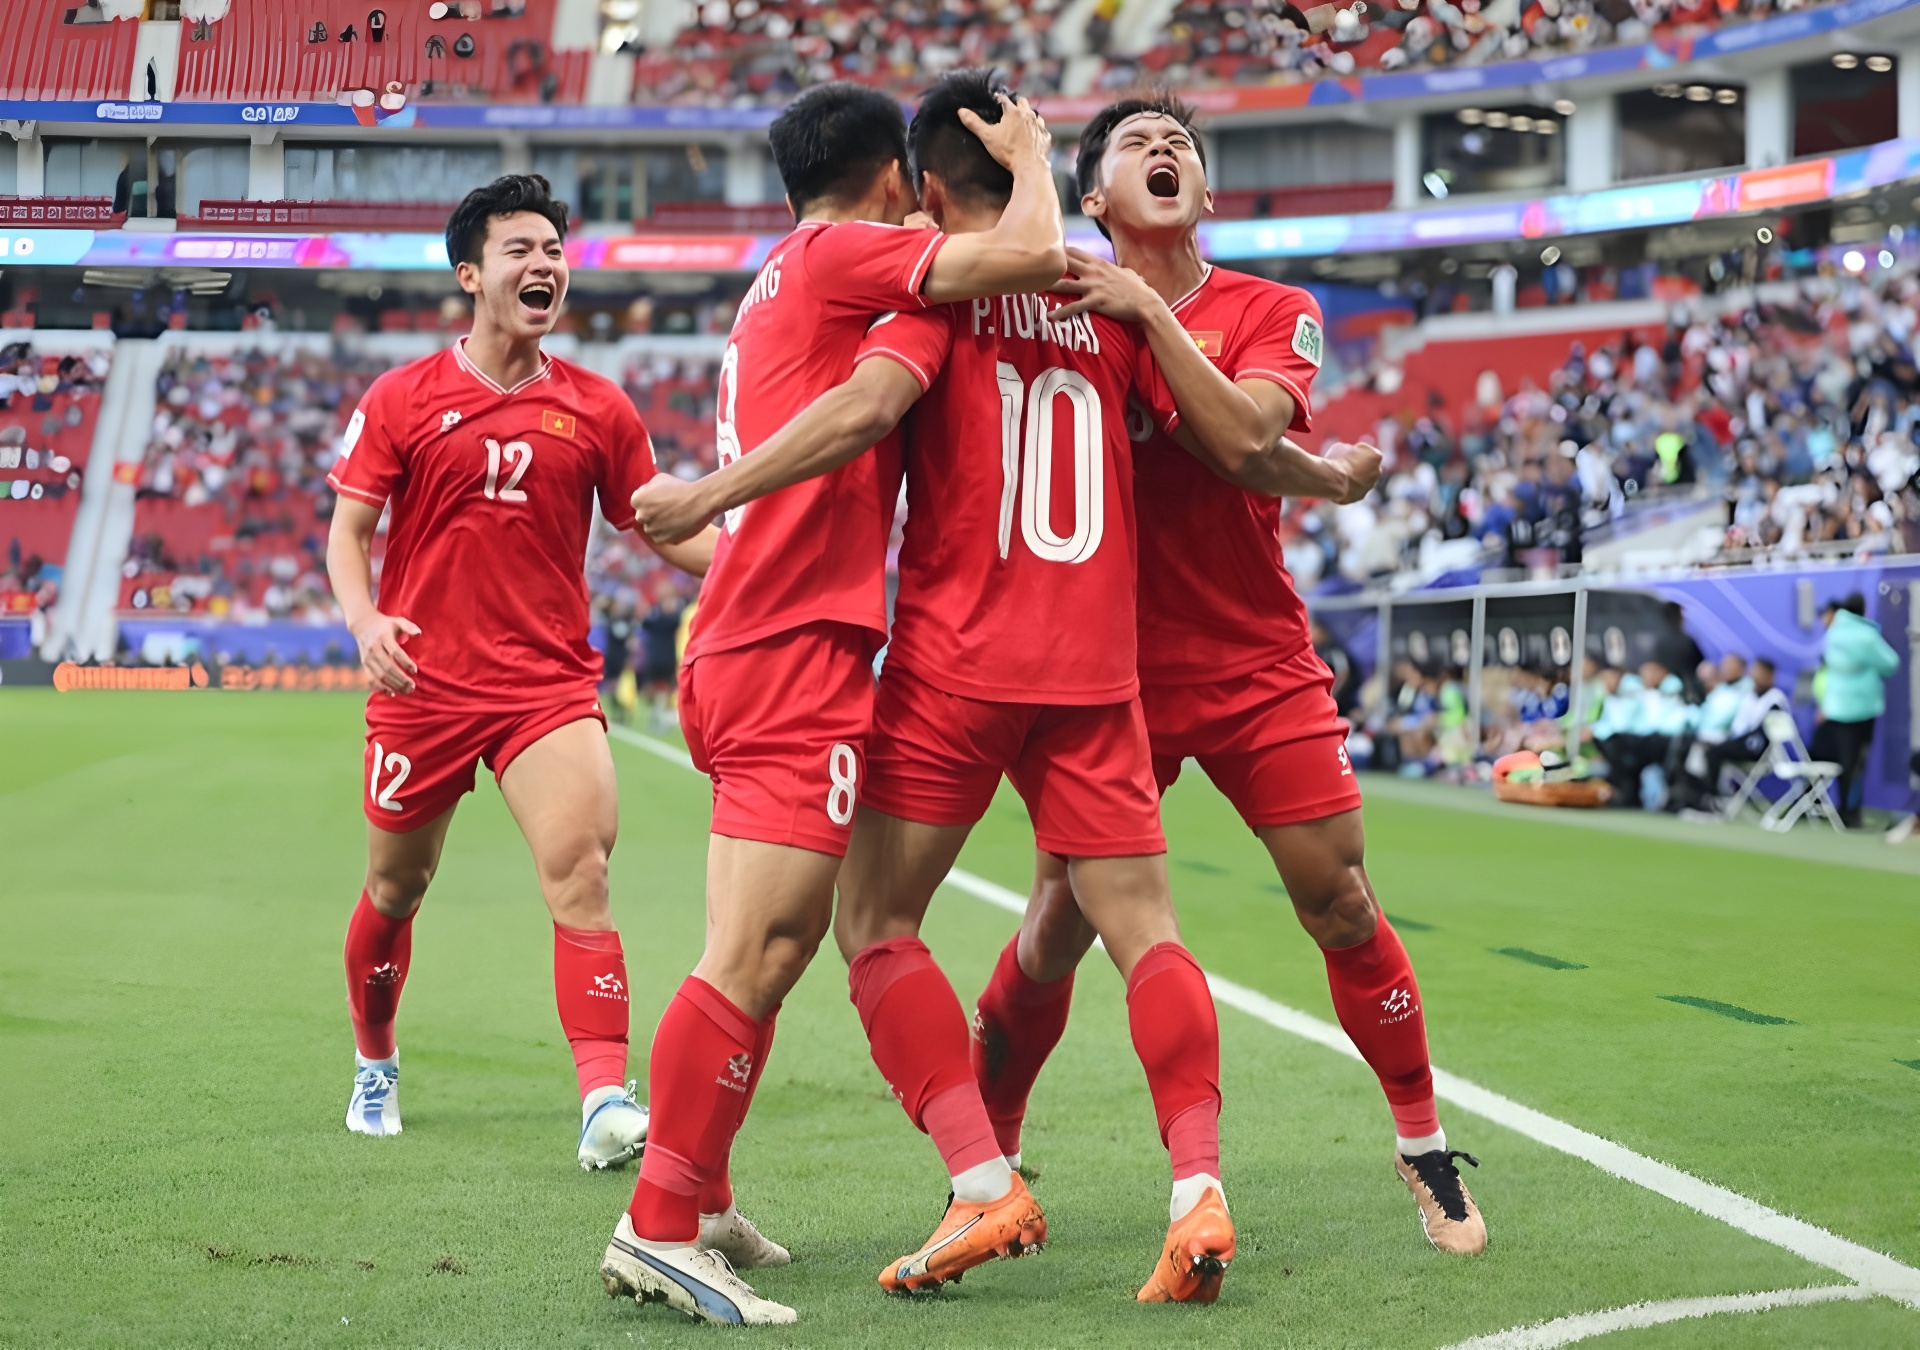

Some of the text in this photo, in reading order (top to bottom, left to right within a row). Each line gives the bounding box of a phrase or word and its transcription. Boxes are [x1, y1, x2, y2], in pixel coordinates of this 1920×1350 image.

[484, 438, 533, 502] 12
[996, 361, 1104, 564] 10
[370, 741, 411, 811] 12
[826, 743, 857, 825] 8
